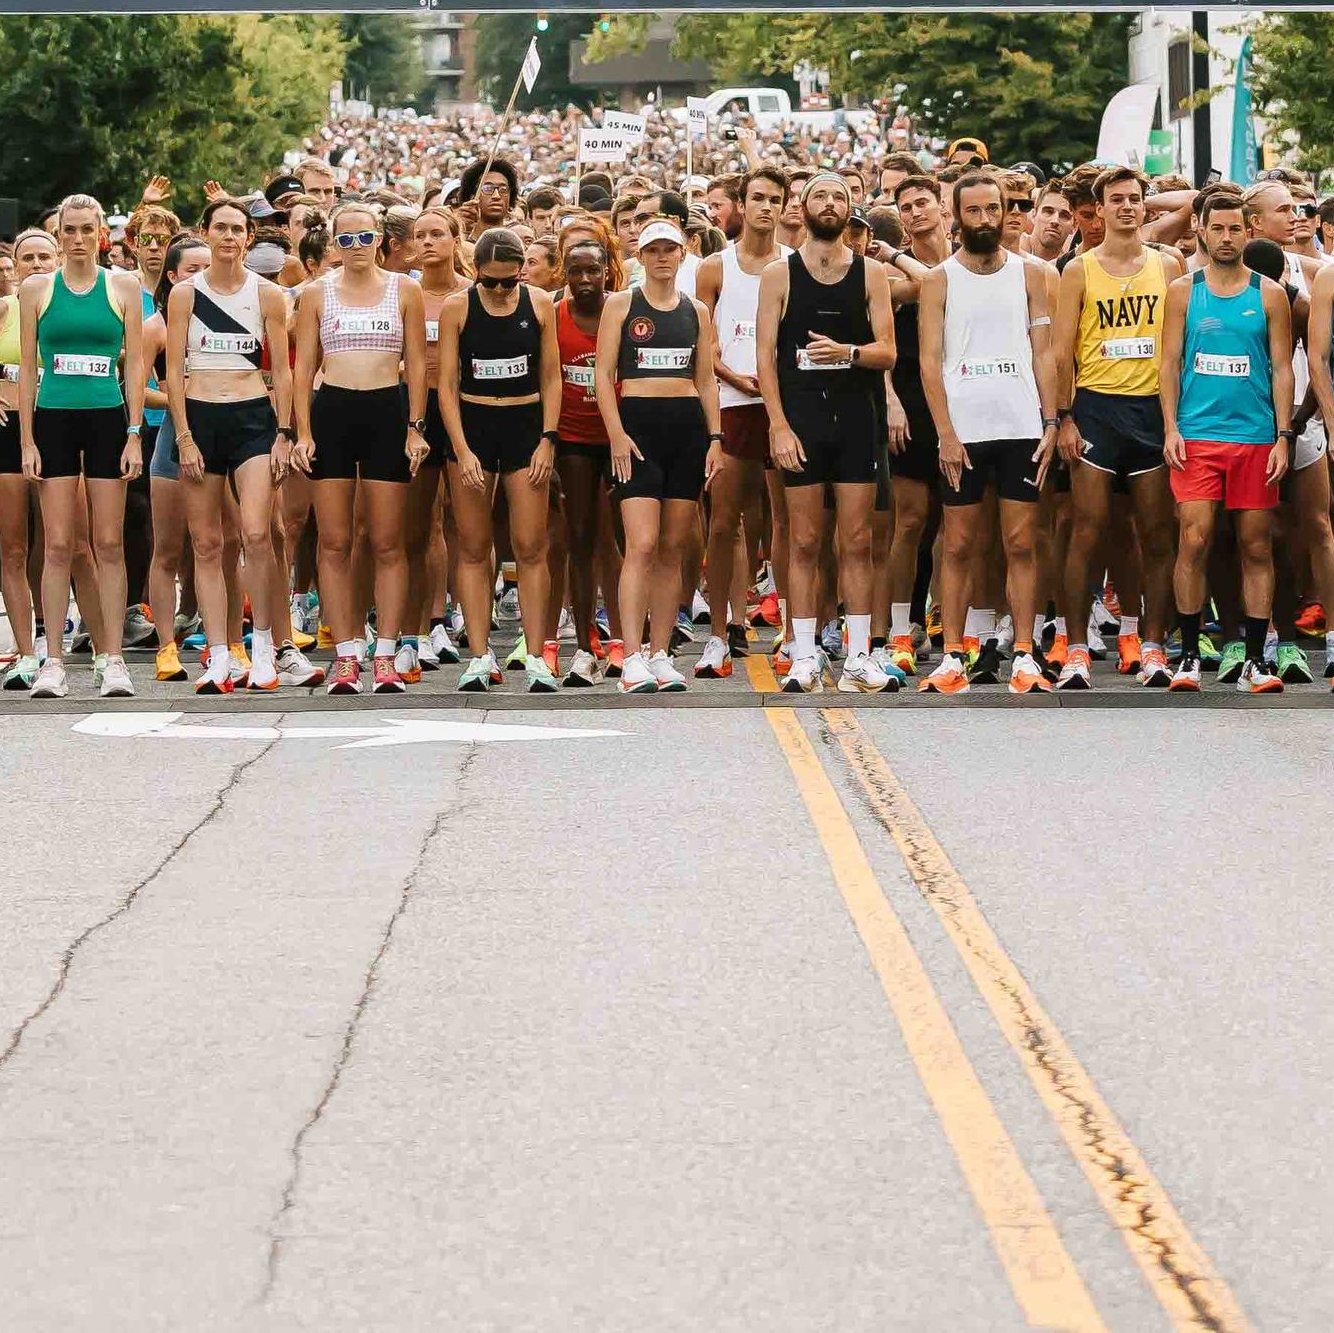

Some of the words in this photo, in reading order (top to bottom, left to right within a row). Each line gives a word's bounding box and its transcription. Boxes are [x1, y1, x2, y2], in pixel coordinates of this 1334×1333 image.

[607, 120, 619, 130] 45
[621, 122, 643, 133] MIN
[584, 139, 599, 149] 40
[601, 139, 623, 149] MIN
[1096, 295, 1159, 329] NAVY
[370, 320, 391, 331] 128
[235, 340, 254, 351] 144
[1137, 344, 1154, 355] 130
[88, 363, 108, 374] 132
[507, 363, 525, 375] 133
[997, 363, 1017, 375] 151
[1228, 362, 1248, 374] 137
